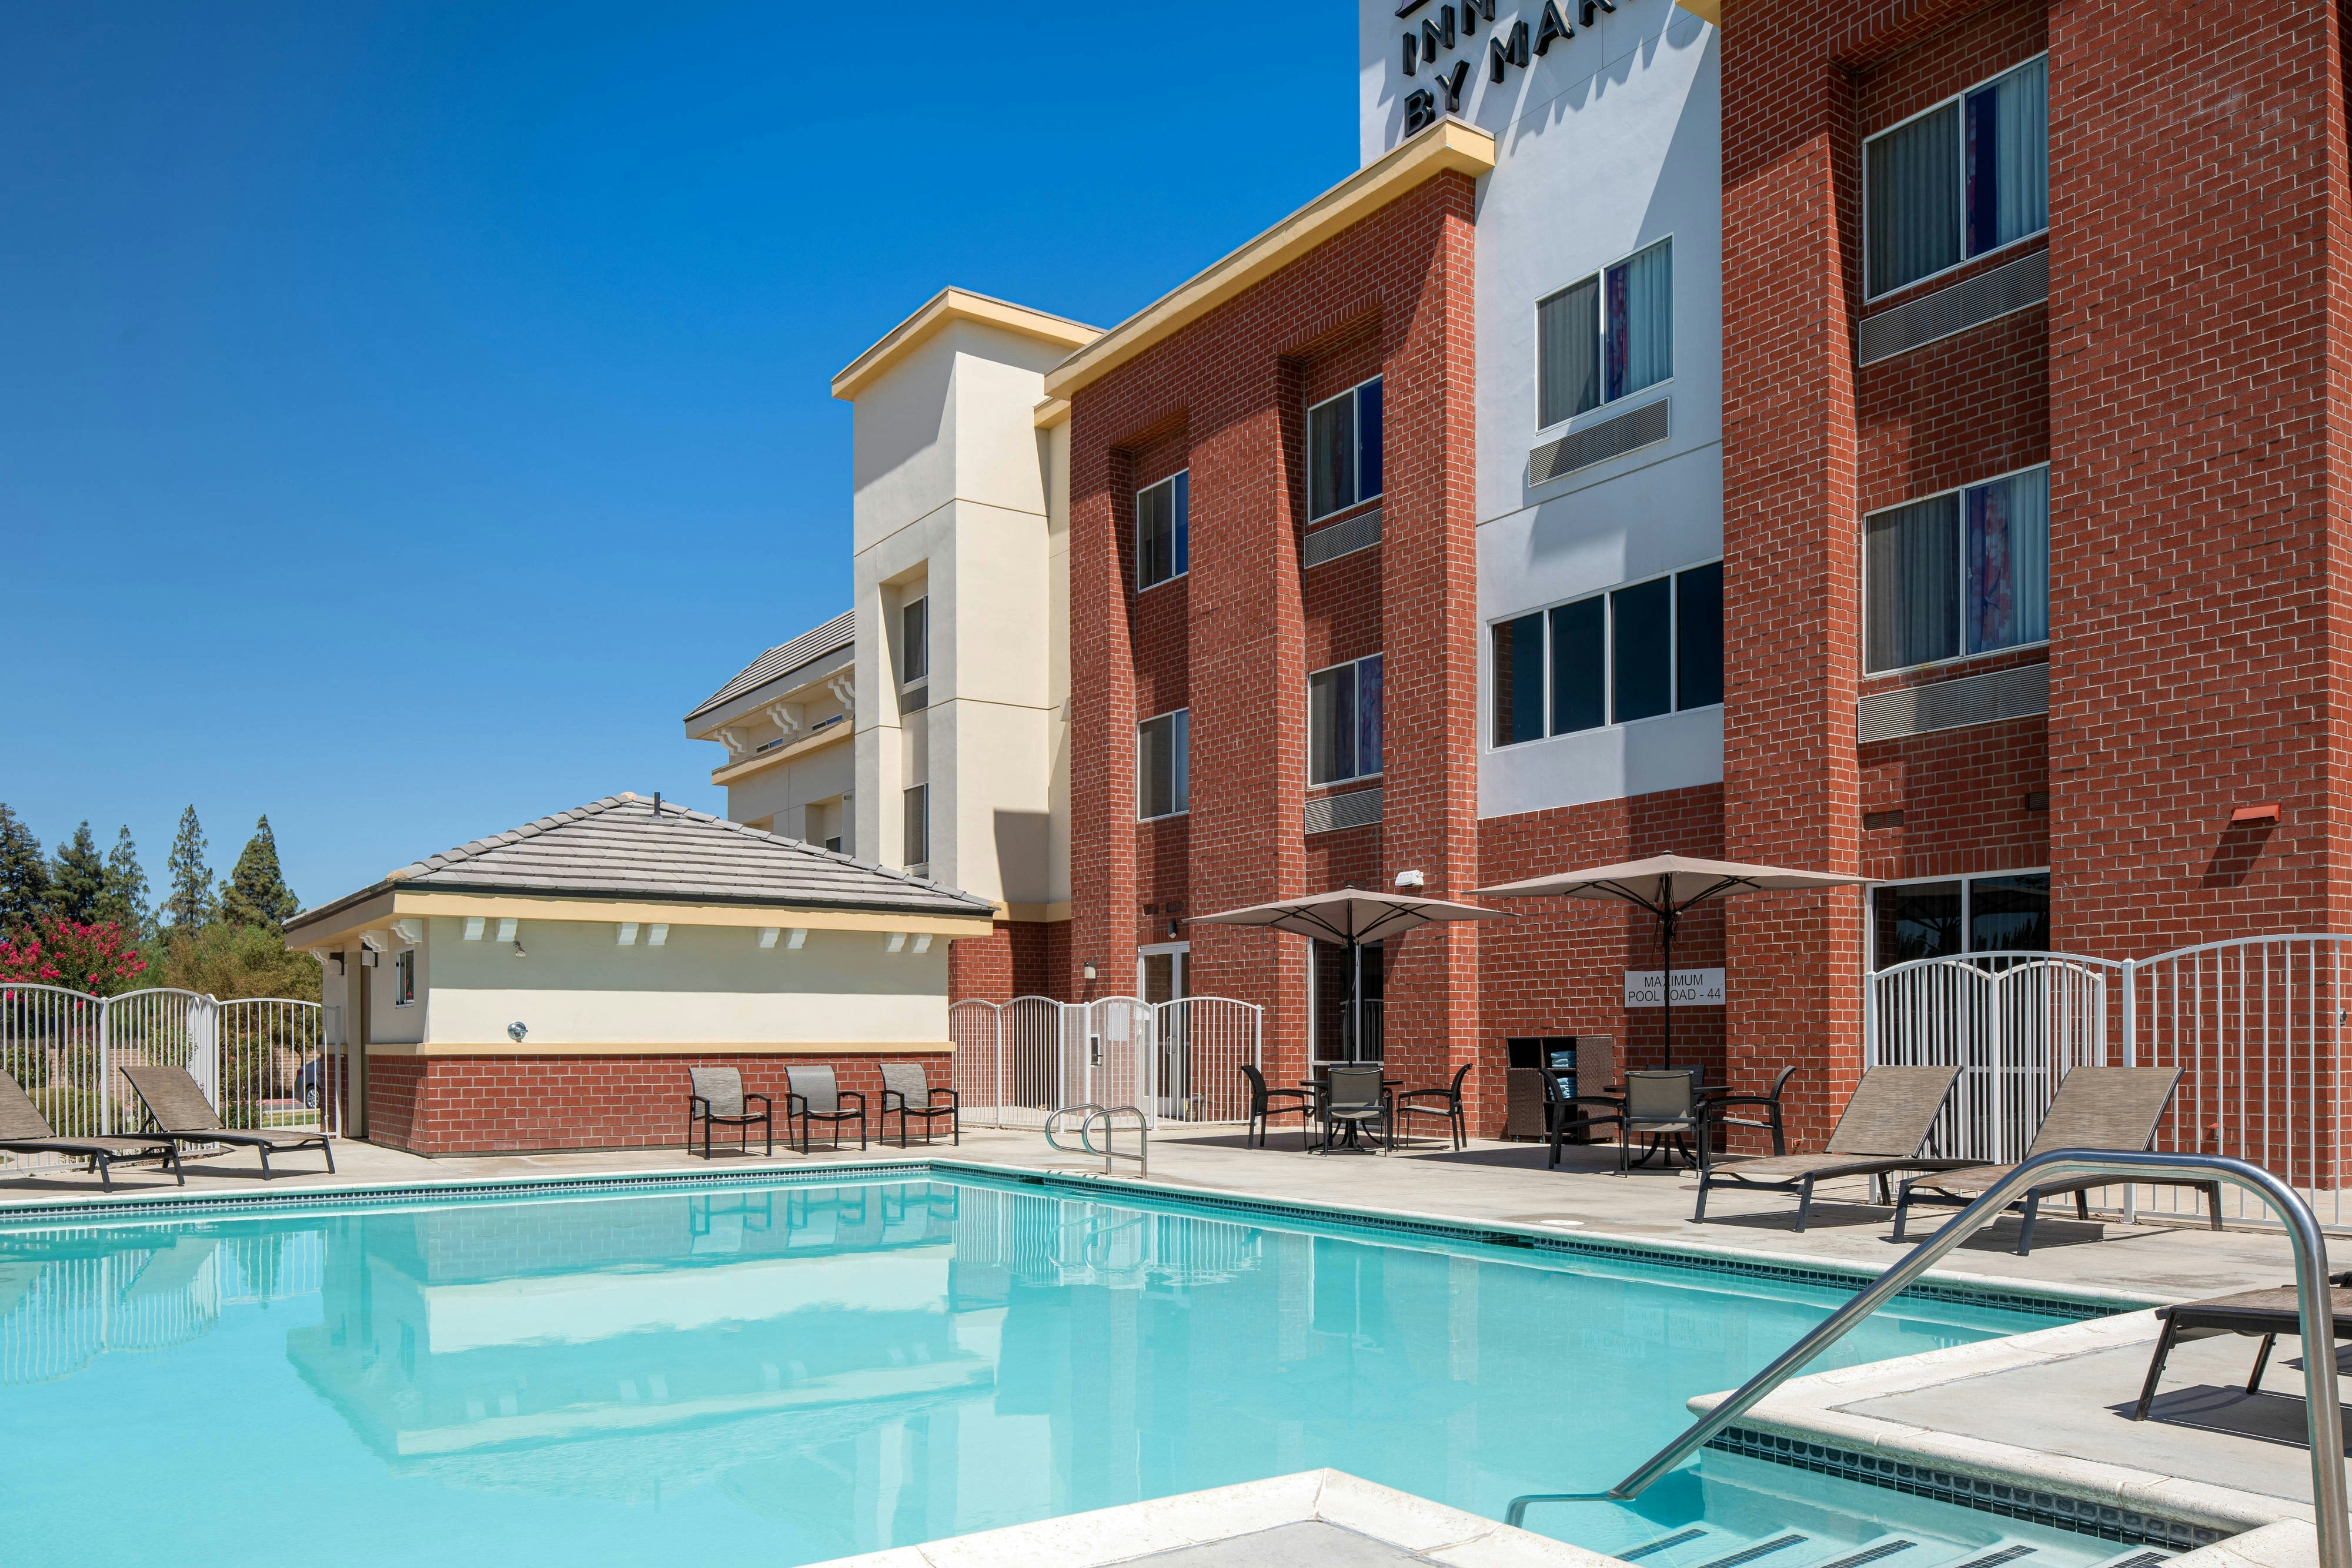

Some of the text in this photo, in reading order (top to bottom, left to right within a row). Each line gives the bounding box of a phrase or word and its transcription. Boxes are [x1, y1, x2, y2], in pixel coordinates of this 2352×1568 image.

[1405, 59, 1470, 137] BY
[1628, 991, 1660, 1002] POOL
[1665, 989, 1696, 1001] OAD
[1708, 988, 1721, 999] 44
